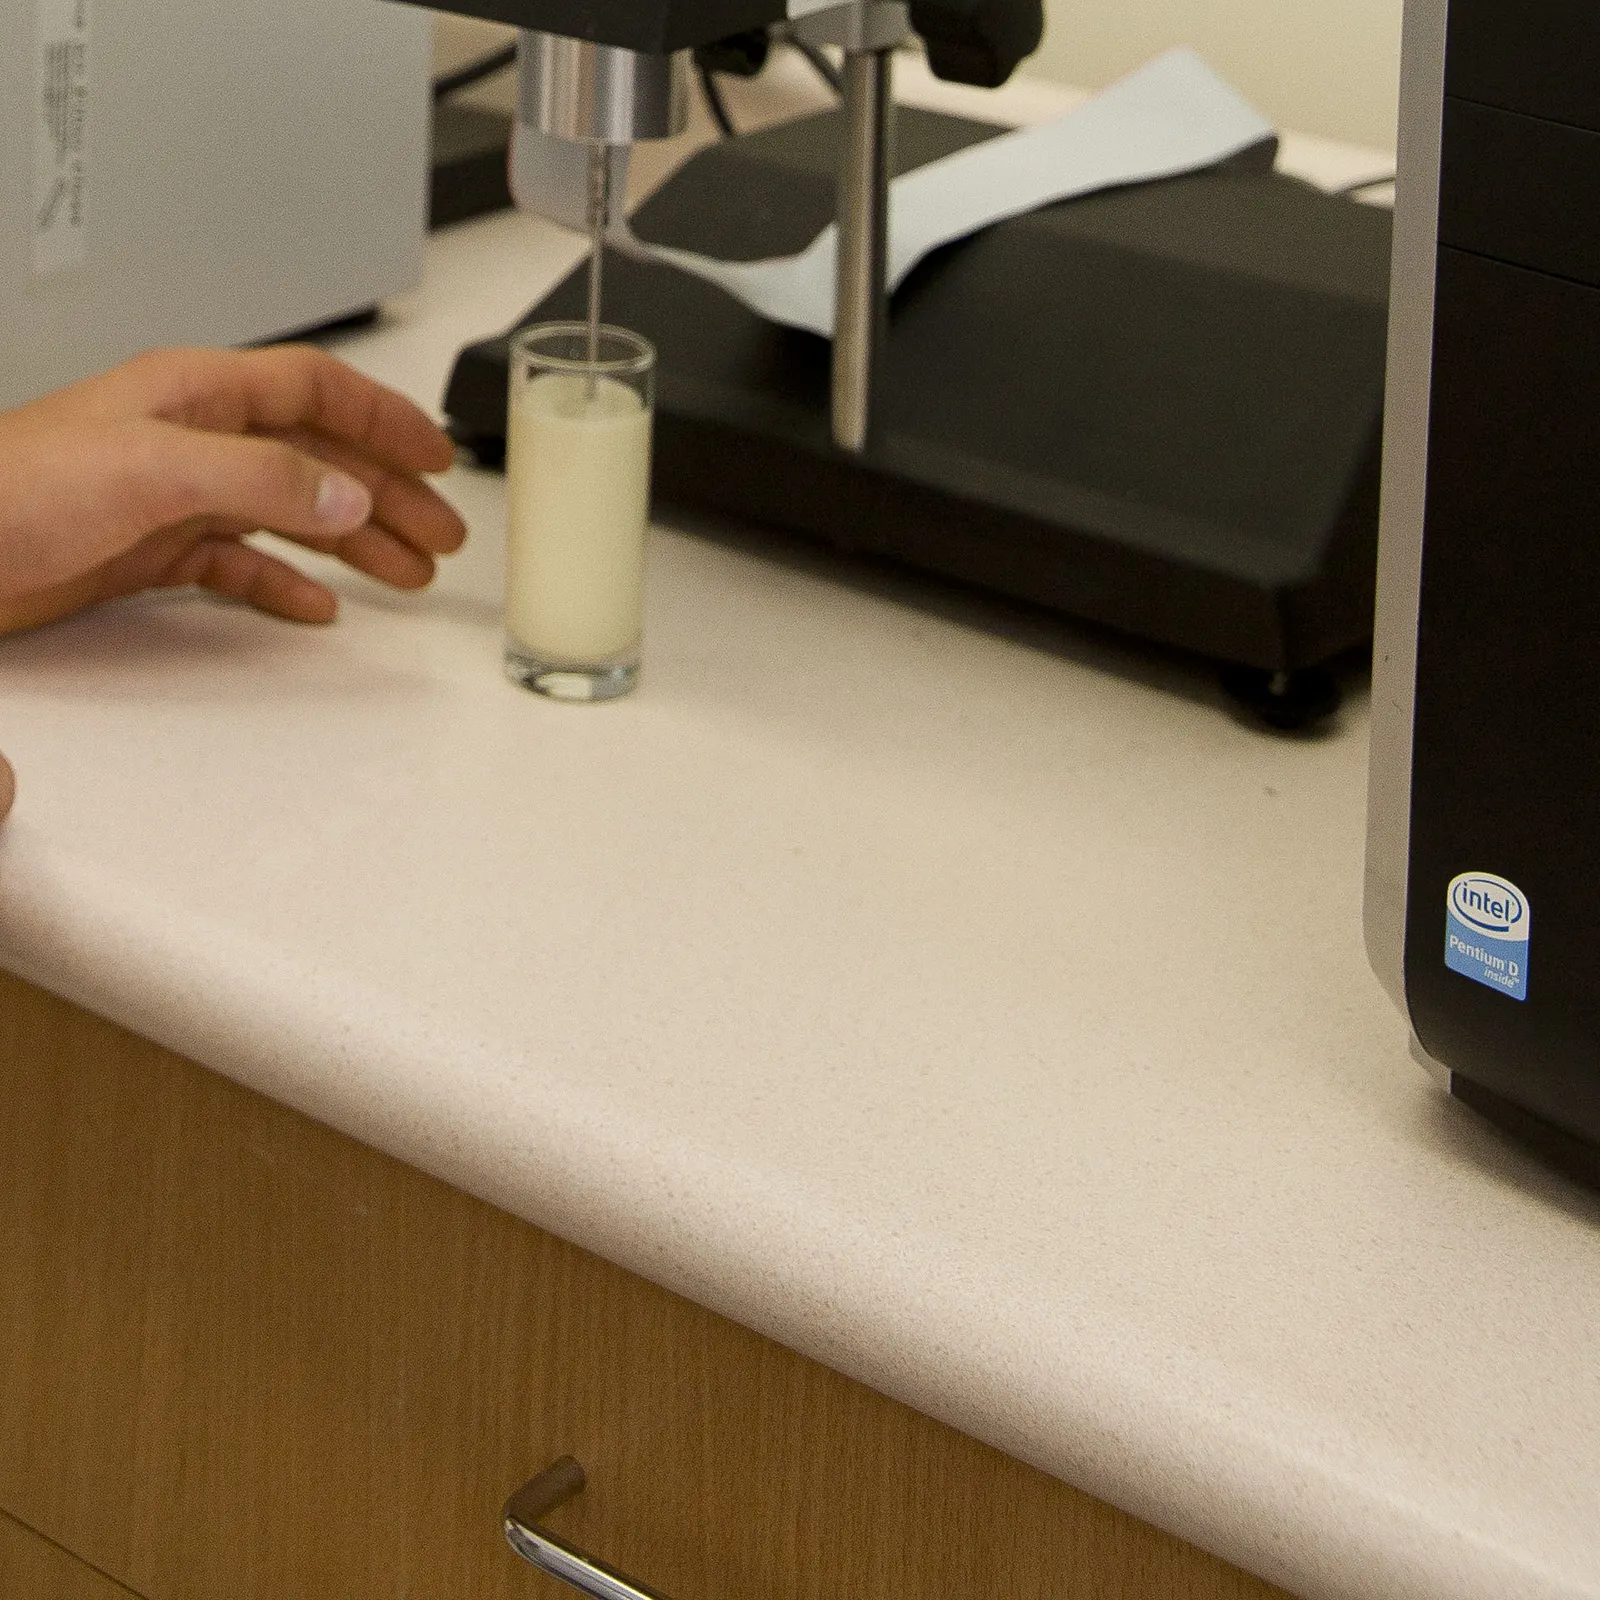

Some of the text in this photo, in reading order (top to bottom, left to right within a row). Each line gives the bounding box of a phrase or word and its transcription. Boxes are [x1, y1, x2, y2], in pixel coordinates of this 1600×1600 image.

[1462, 881, 1510, 922] intel
[1449, 935, 1519, 977] Pentium D
